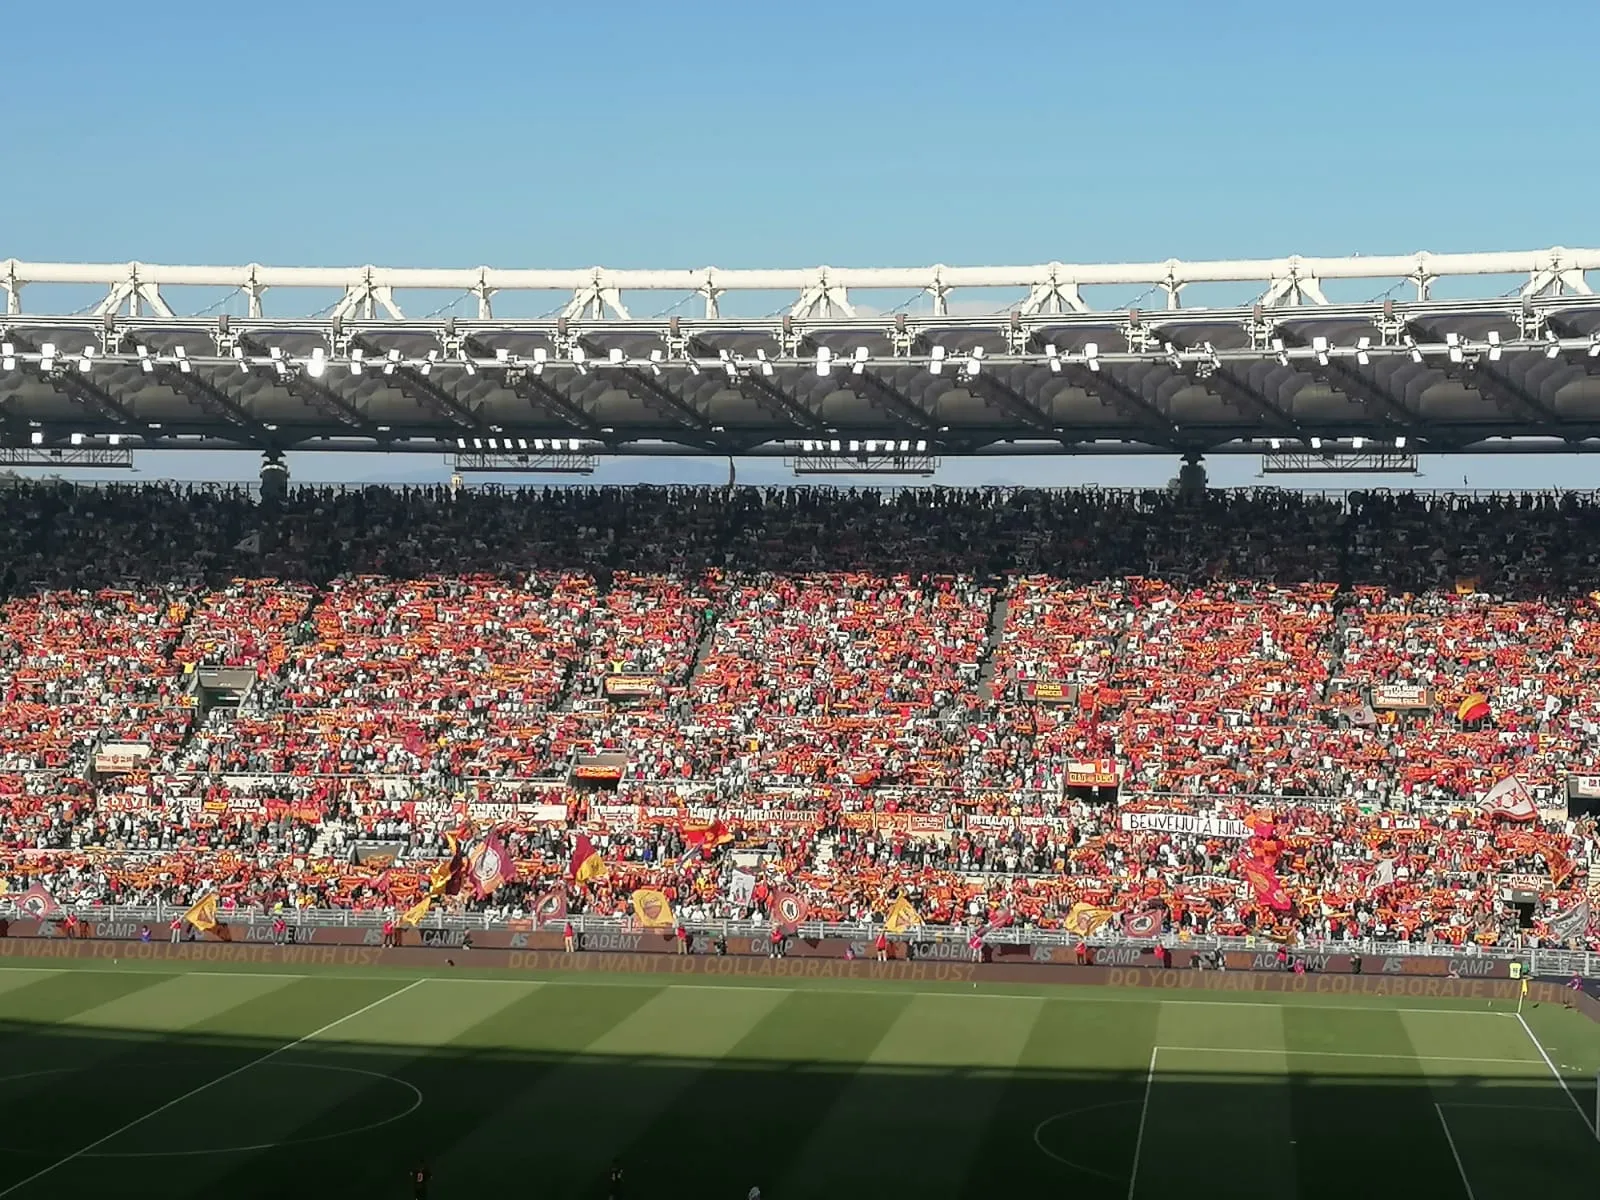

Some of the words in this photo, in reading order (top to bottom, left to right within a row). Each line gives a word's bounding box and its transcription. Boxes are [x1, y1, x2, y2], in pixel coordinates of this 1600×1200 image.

[1129, 814, 1213, 834] BENVENUTA
[96, 922, 137, 937] CAMP
[246, 926, 316, 942] ACAEMY
[510, 933, 529, 948] AS
[23, 941, 81, 957] WANT
[93, 942, 117, 958] TO
[124, 943, 273, 962] COLLABORATE
[283, 947, 337, 963] WITH
[344, 949, 383, 965] US?
[912, 943, 974, 961] ACADEM
[1032, 947, 1052, 962] AS
[1095, 949, 1141, 964] CAMP
[508, 951, 540, 968] DO
[550, 953, 590, 970] YOU
[600, 954, 659, 972] WANT
[670, 956, 696, 973] TO
[704, 957, 860, 979] COLLABORATE
[870, 962, 926, 980] WITH
[936, 963, 977, 981] US?
[1382, 957, 1401, 973] AS
[1448, 959, 1494, 976] CAMP
[1109, 970, 1141, 986] DO
[1150, 970, 1194, 988] YOU
[1203, 971, 1268, 990] WANT
[1279, 974, 1307, 992] TO
[1316, 974, 1482, 998] COLLABORATE
